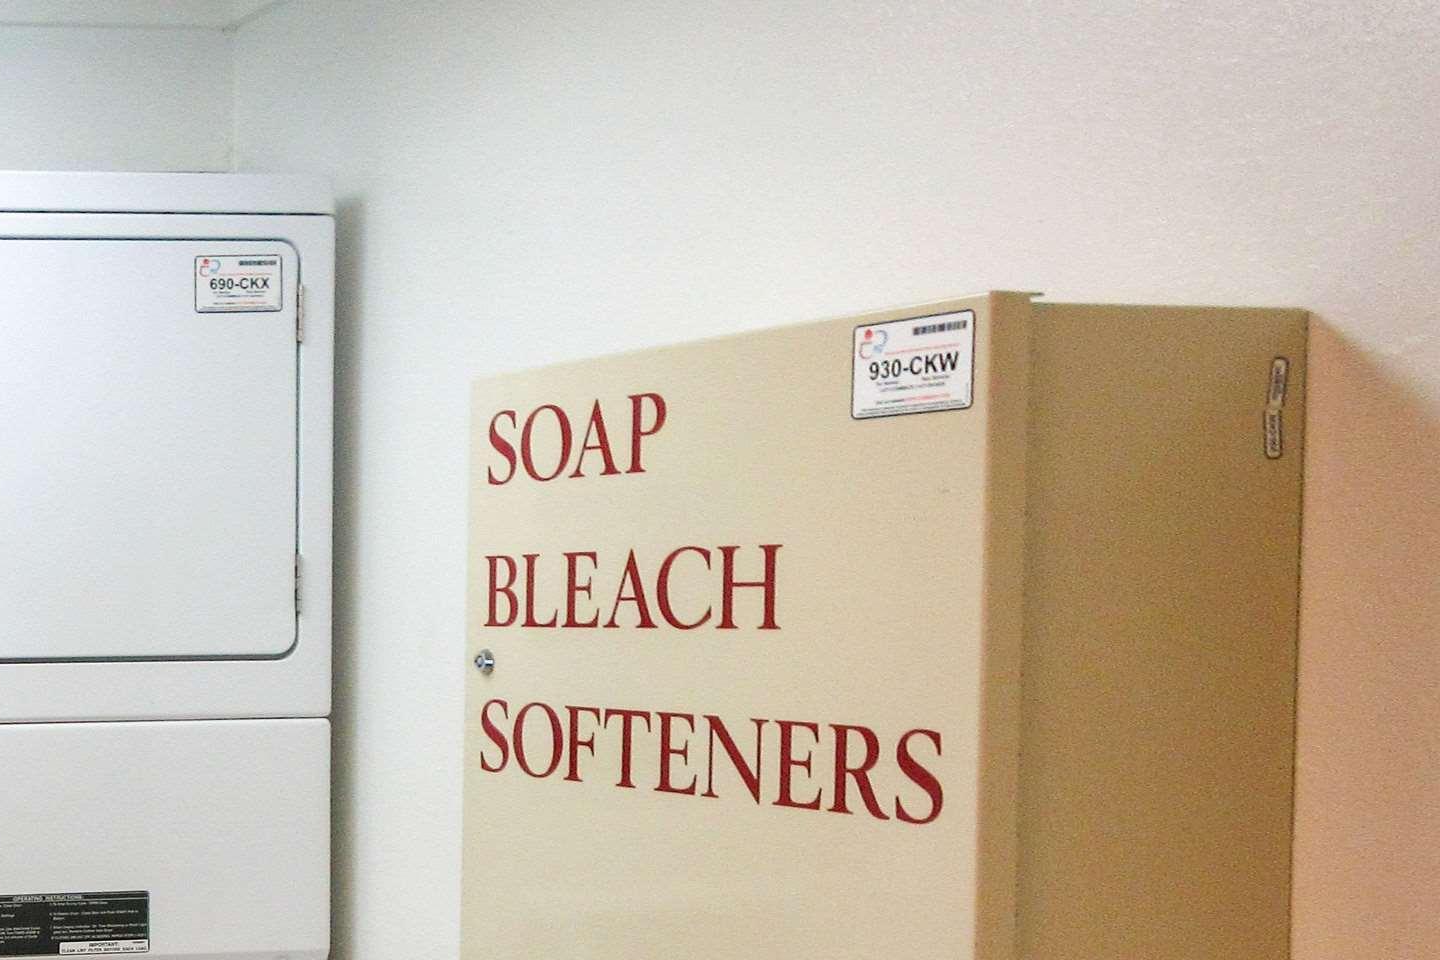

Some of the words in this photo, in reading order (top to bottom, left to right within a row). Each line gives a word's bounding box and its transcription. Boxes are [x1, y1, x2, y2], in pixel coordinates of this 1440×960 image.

[210, 277, 270, 290] 690-CKX
[869, 351, 959, 380] 930-CKW
[486, 392, 669, 486] SOAP
[484, 544, 783, 631] BLEACH
[479, 699, 945, 825] SOFTENERS
